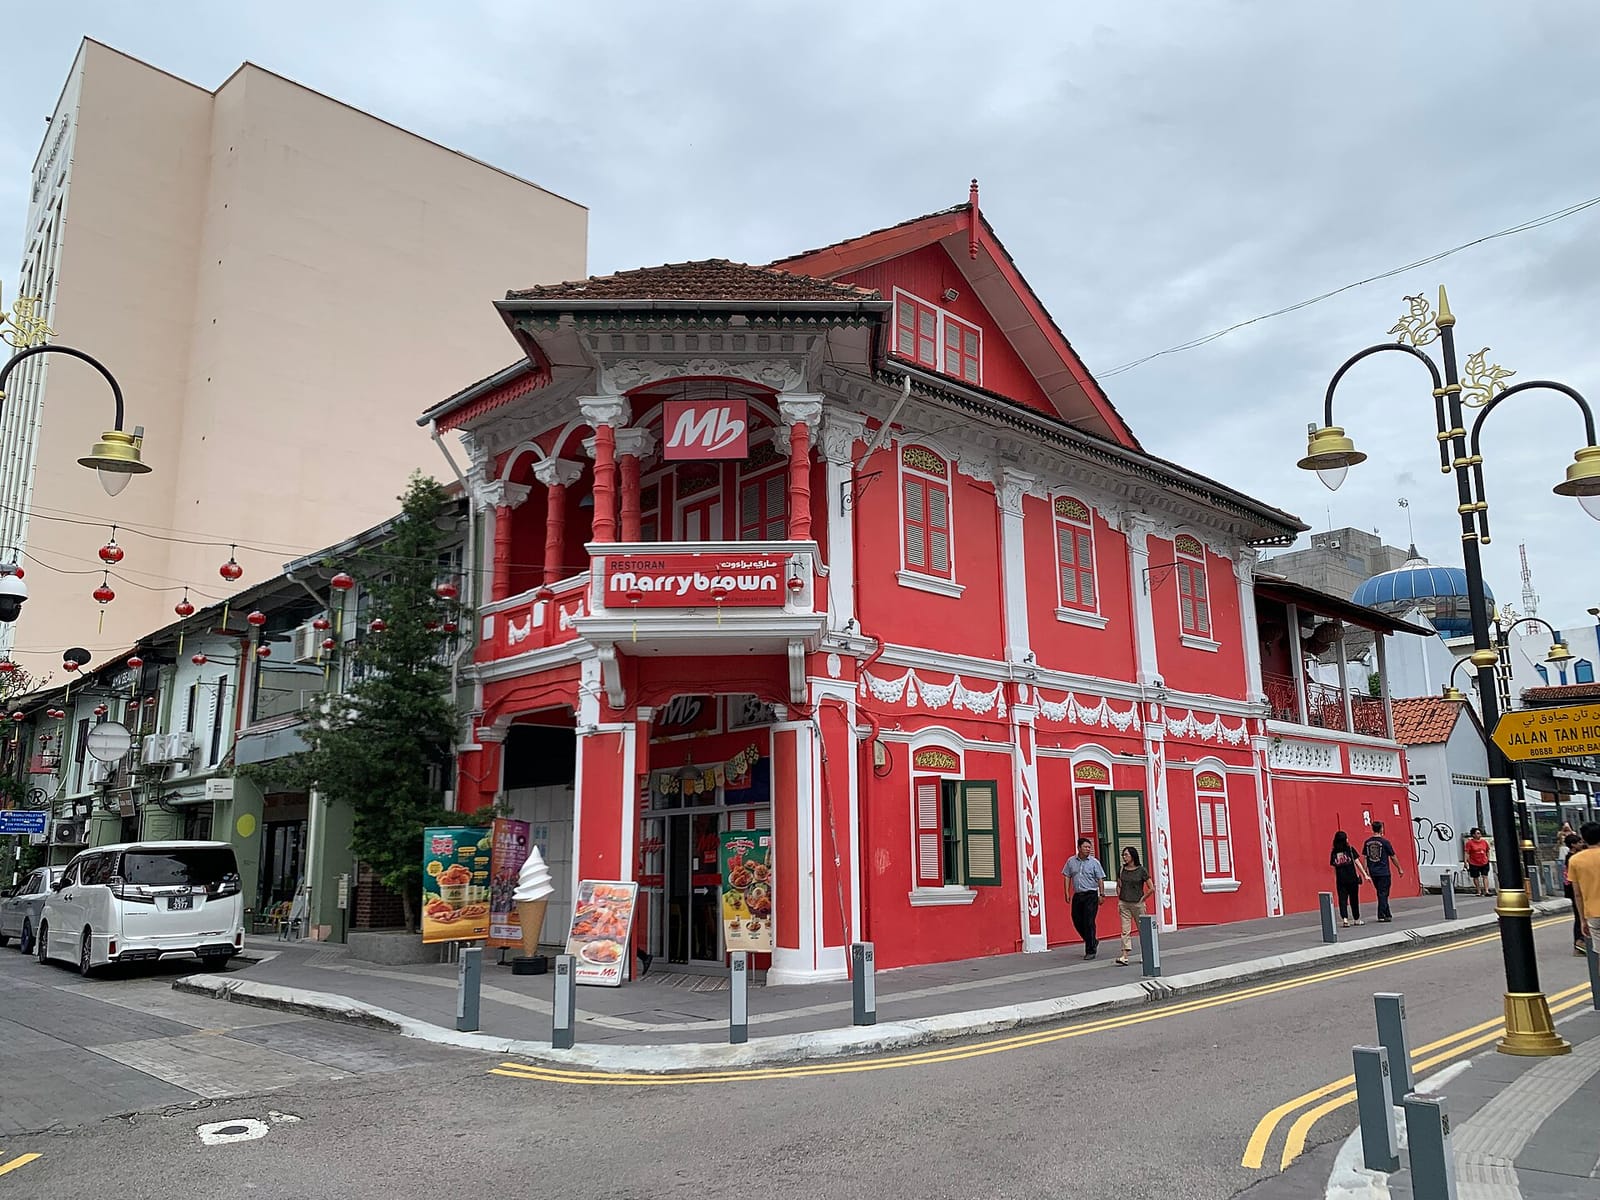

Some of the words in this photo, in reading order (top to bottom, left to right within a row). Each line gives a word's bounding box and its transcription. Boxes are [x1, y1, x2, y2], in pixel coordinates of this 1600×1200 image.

[666, 407, 745, 452] Mb
[611, 561, 665, 571] RESTORAN
[1508, 730, 1548, 746] JALAN
[1554, 727, 1579, 742] TAN
[1557, 744, 1585, 754] JOHOR
[1587, 743, 1600, 752] BA
